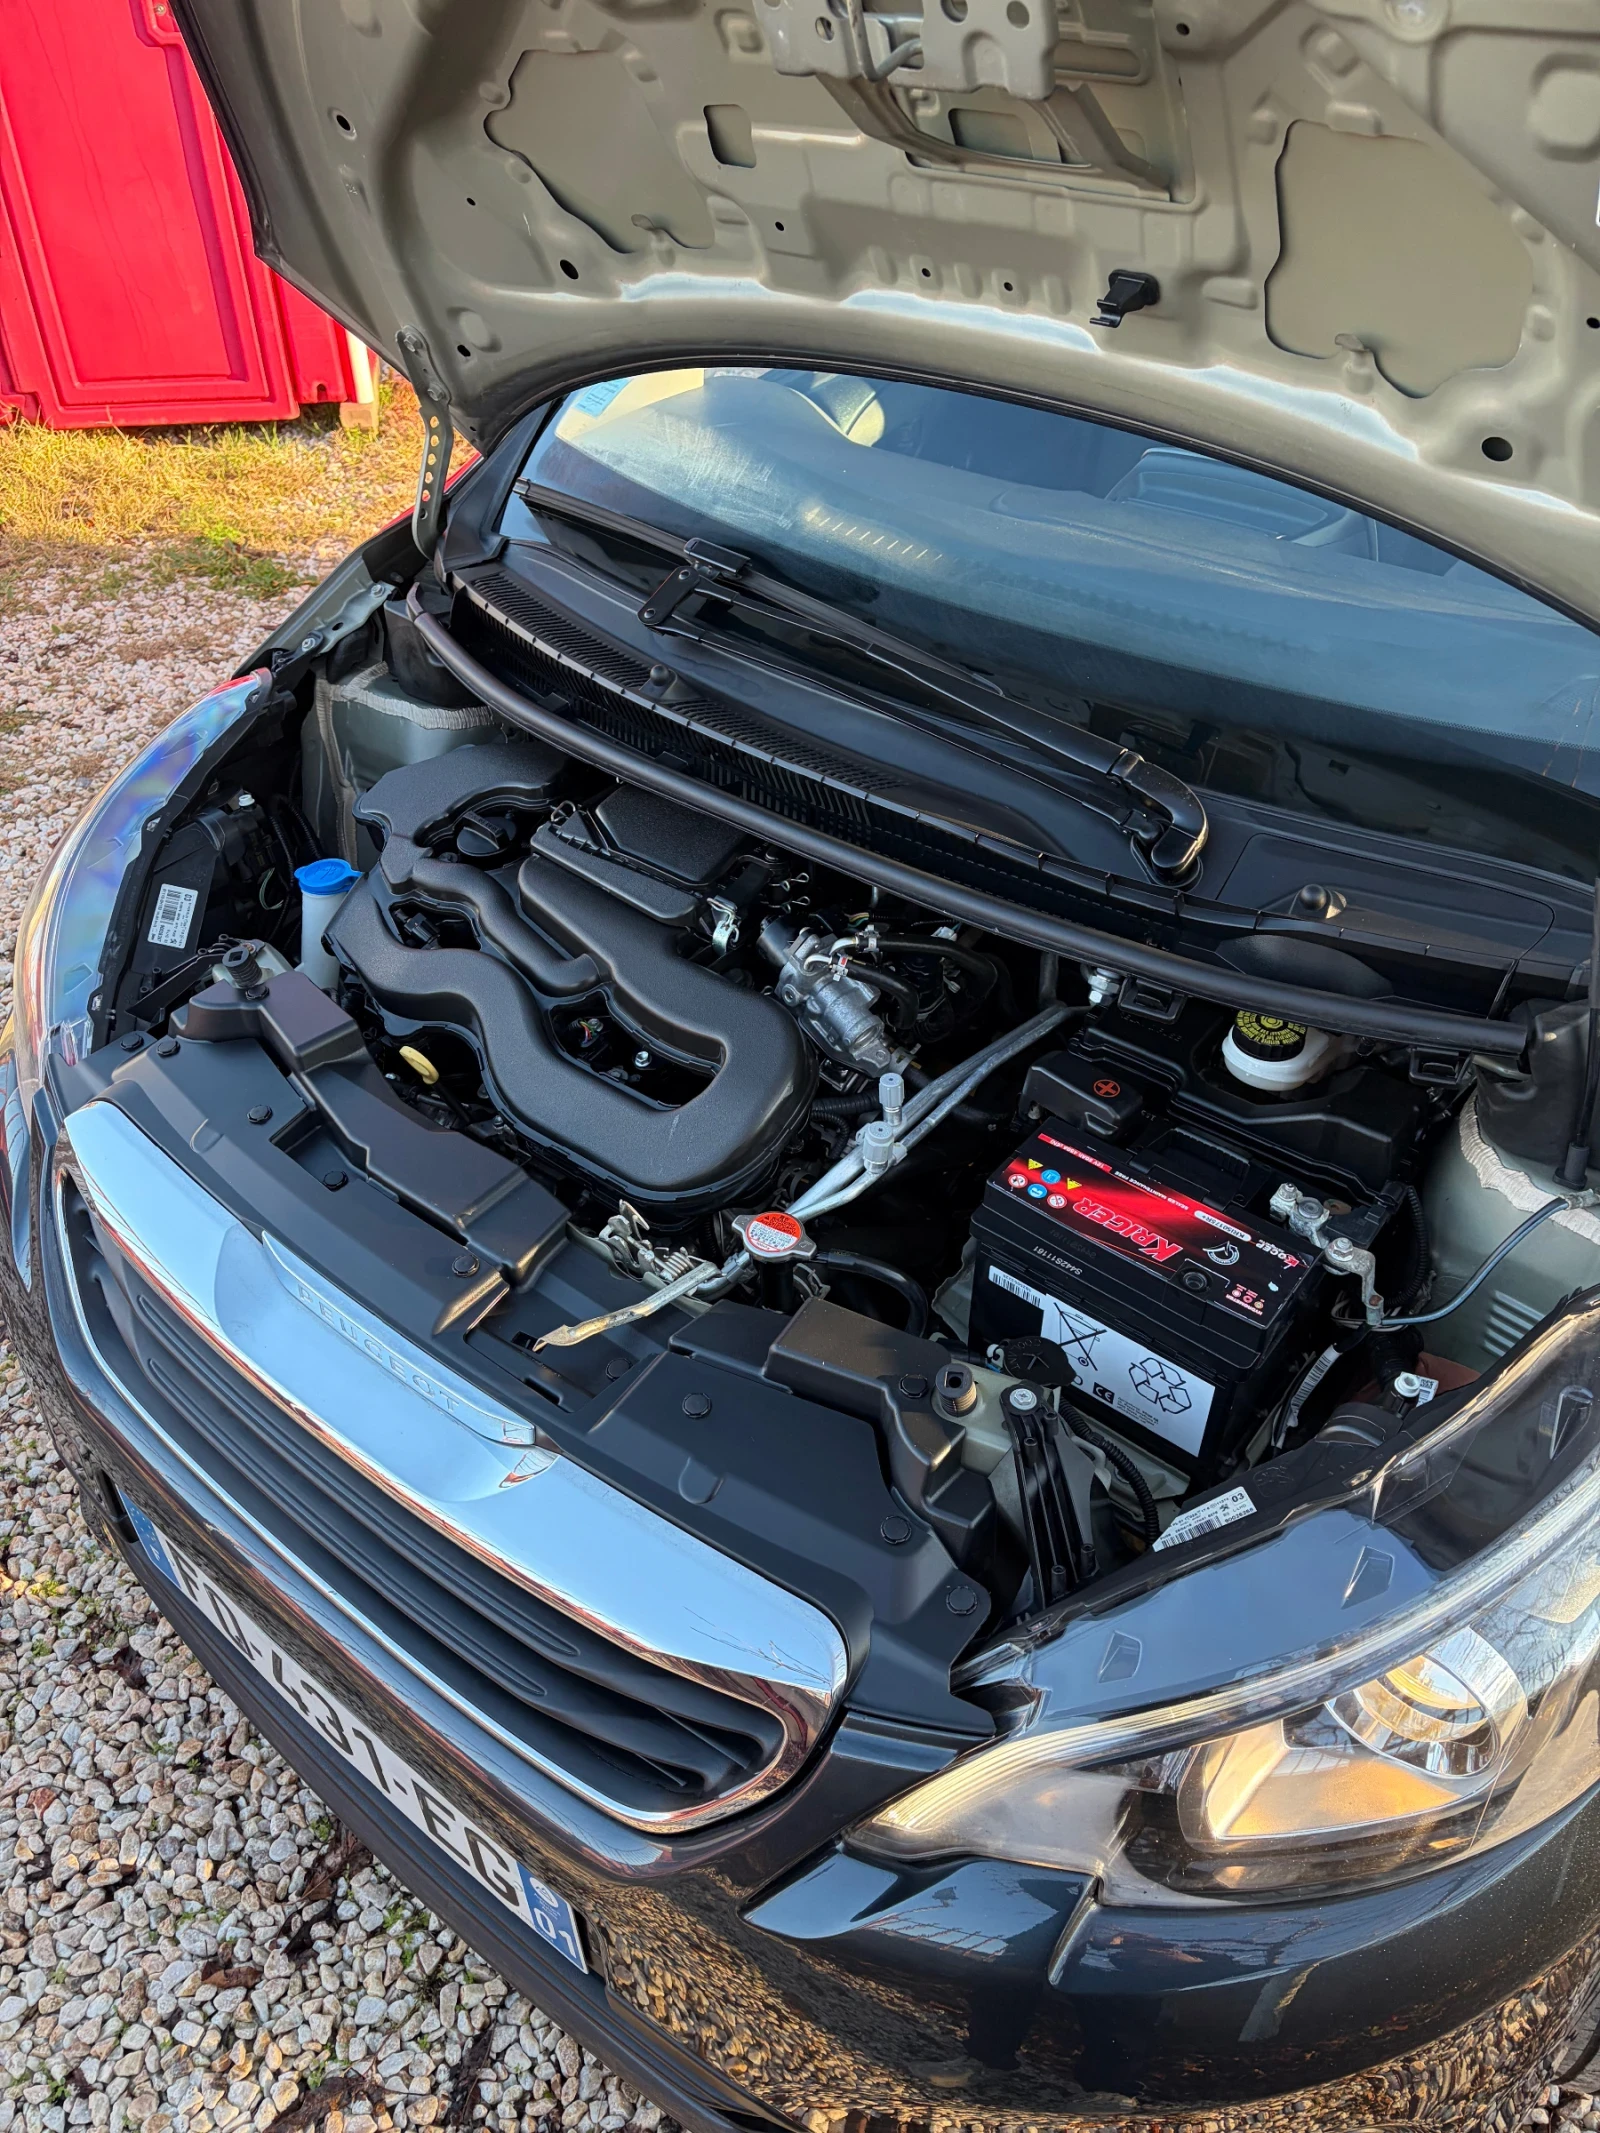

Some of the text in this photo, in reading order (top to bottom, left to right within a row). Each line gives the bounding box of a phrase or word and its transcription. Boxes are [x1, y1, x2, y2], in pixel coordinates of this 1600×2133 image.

[1114, 1170, 1188, 1210] SEALED MAINTENANCE FREE
[1073, 1197, 1183, 1262] KRIGER
[1225, 1293, 1262, 1315] HYDROMETER
[298, 1284, 460, 1413] PEUGEOT
[1231, 1492, 1244, 1502] 03
[165, 1539, 519, 1908] FQ-431-EG
[534, 1906, 576, 1959] 01
